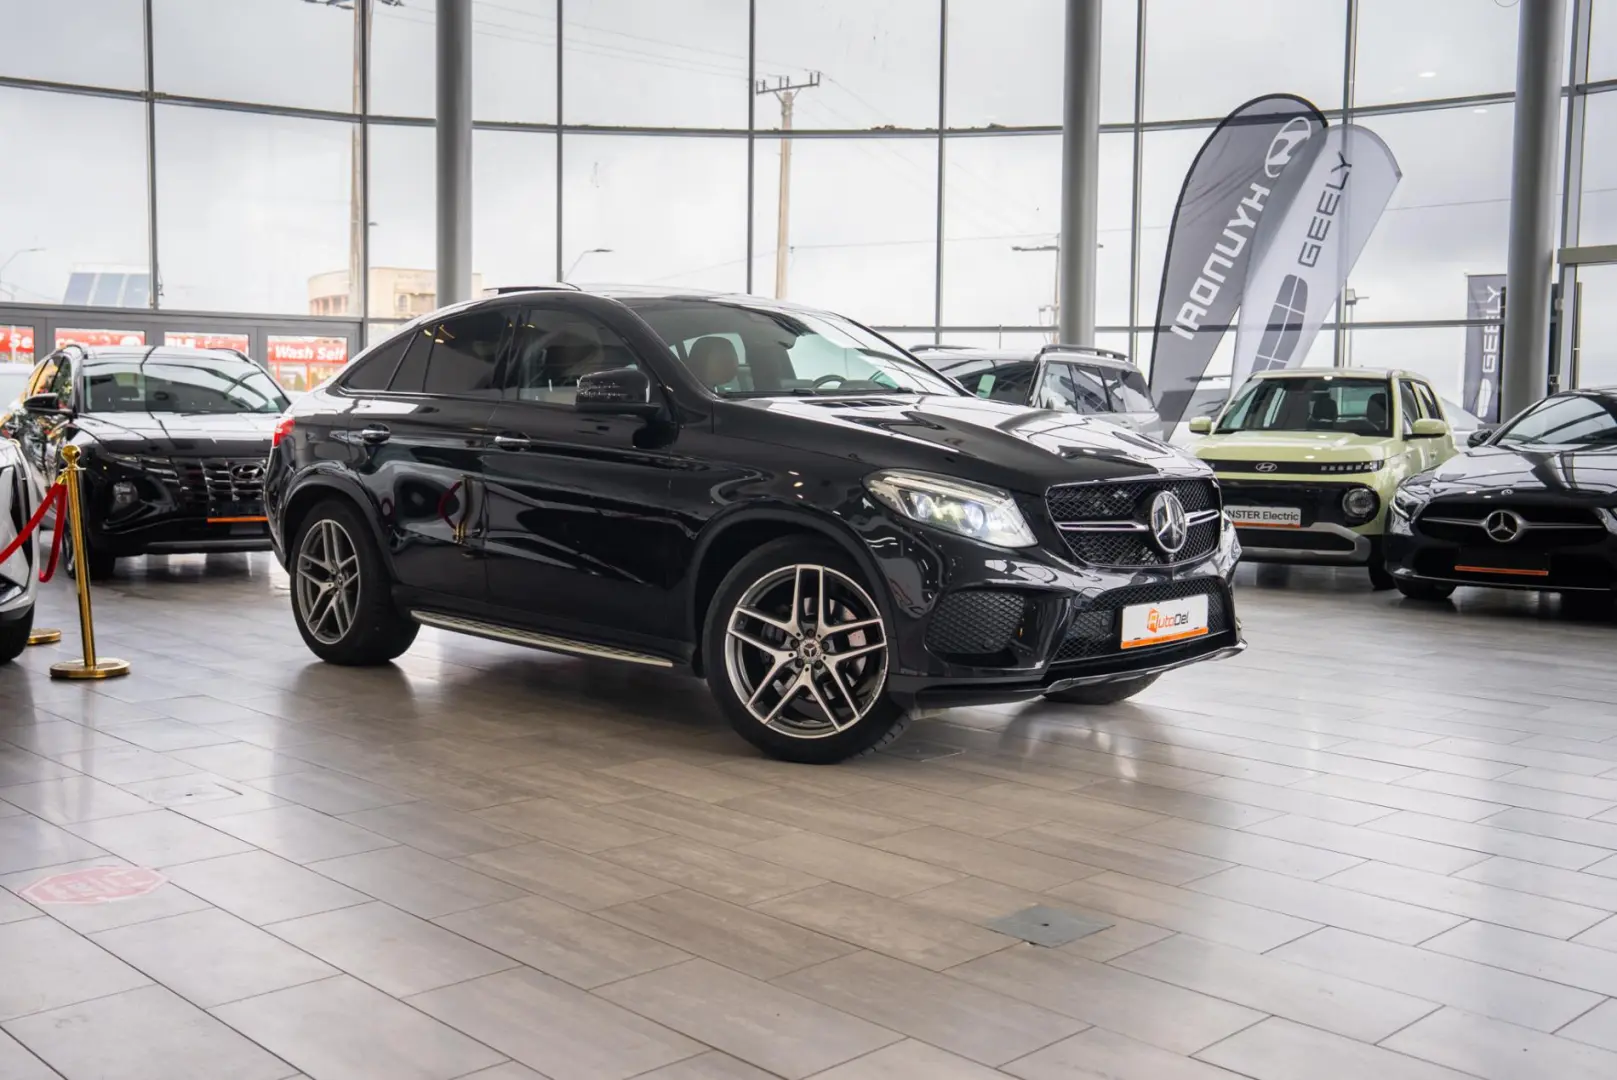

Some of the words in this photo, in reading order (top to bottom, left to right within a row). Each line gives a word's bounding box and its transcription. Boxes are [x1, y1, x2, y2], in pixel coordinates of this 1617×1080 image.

[1297, 151, 1352, 268] GEELY
[1482, 285, 1501, 373] GEELY
[275, 344, 314, 359] Wash
[317, 346, 346, 361] Self
[1262, 511, 1299, 521] Electric
[1146, 607, 1190, 633] AutoDel
